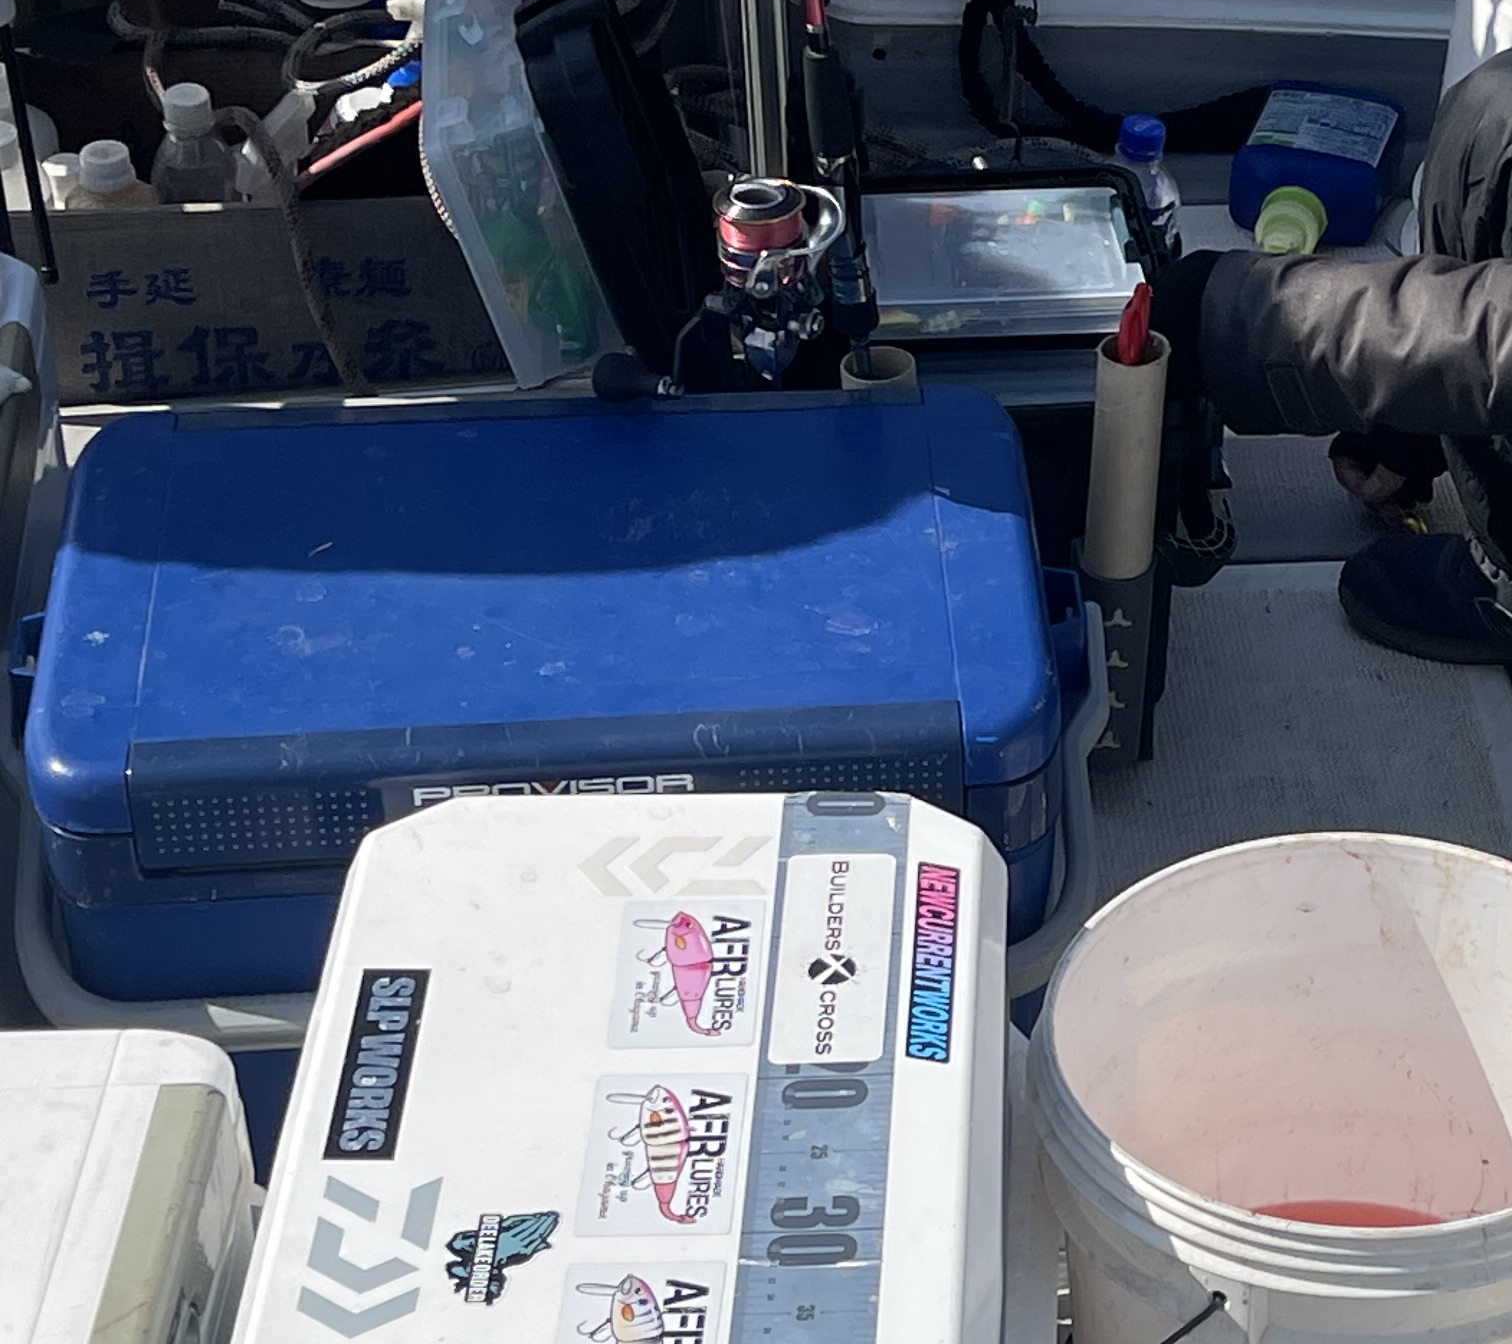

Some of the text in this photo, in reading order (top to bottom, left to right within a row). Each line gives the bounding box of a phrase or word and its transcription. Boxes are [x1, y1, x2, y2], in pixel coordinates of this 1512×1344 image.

[815, 860, 850, 1056] BUILDERS CROSS
[907, 863, 958, 1061] NEWCURRENTWORKS
[711, 978, 736, 1031] LURES
[338, 976, 416, 1151] SLP WORKS
[781, 1062, 869, 1109] 0
[810, 1145, 828, 1159] 25
[685, 1158, 714, 1218] LURES
[766, 1195, 861, 1267] 30
[796, 1304, 815, 1322] 35
